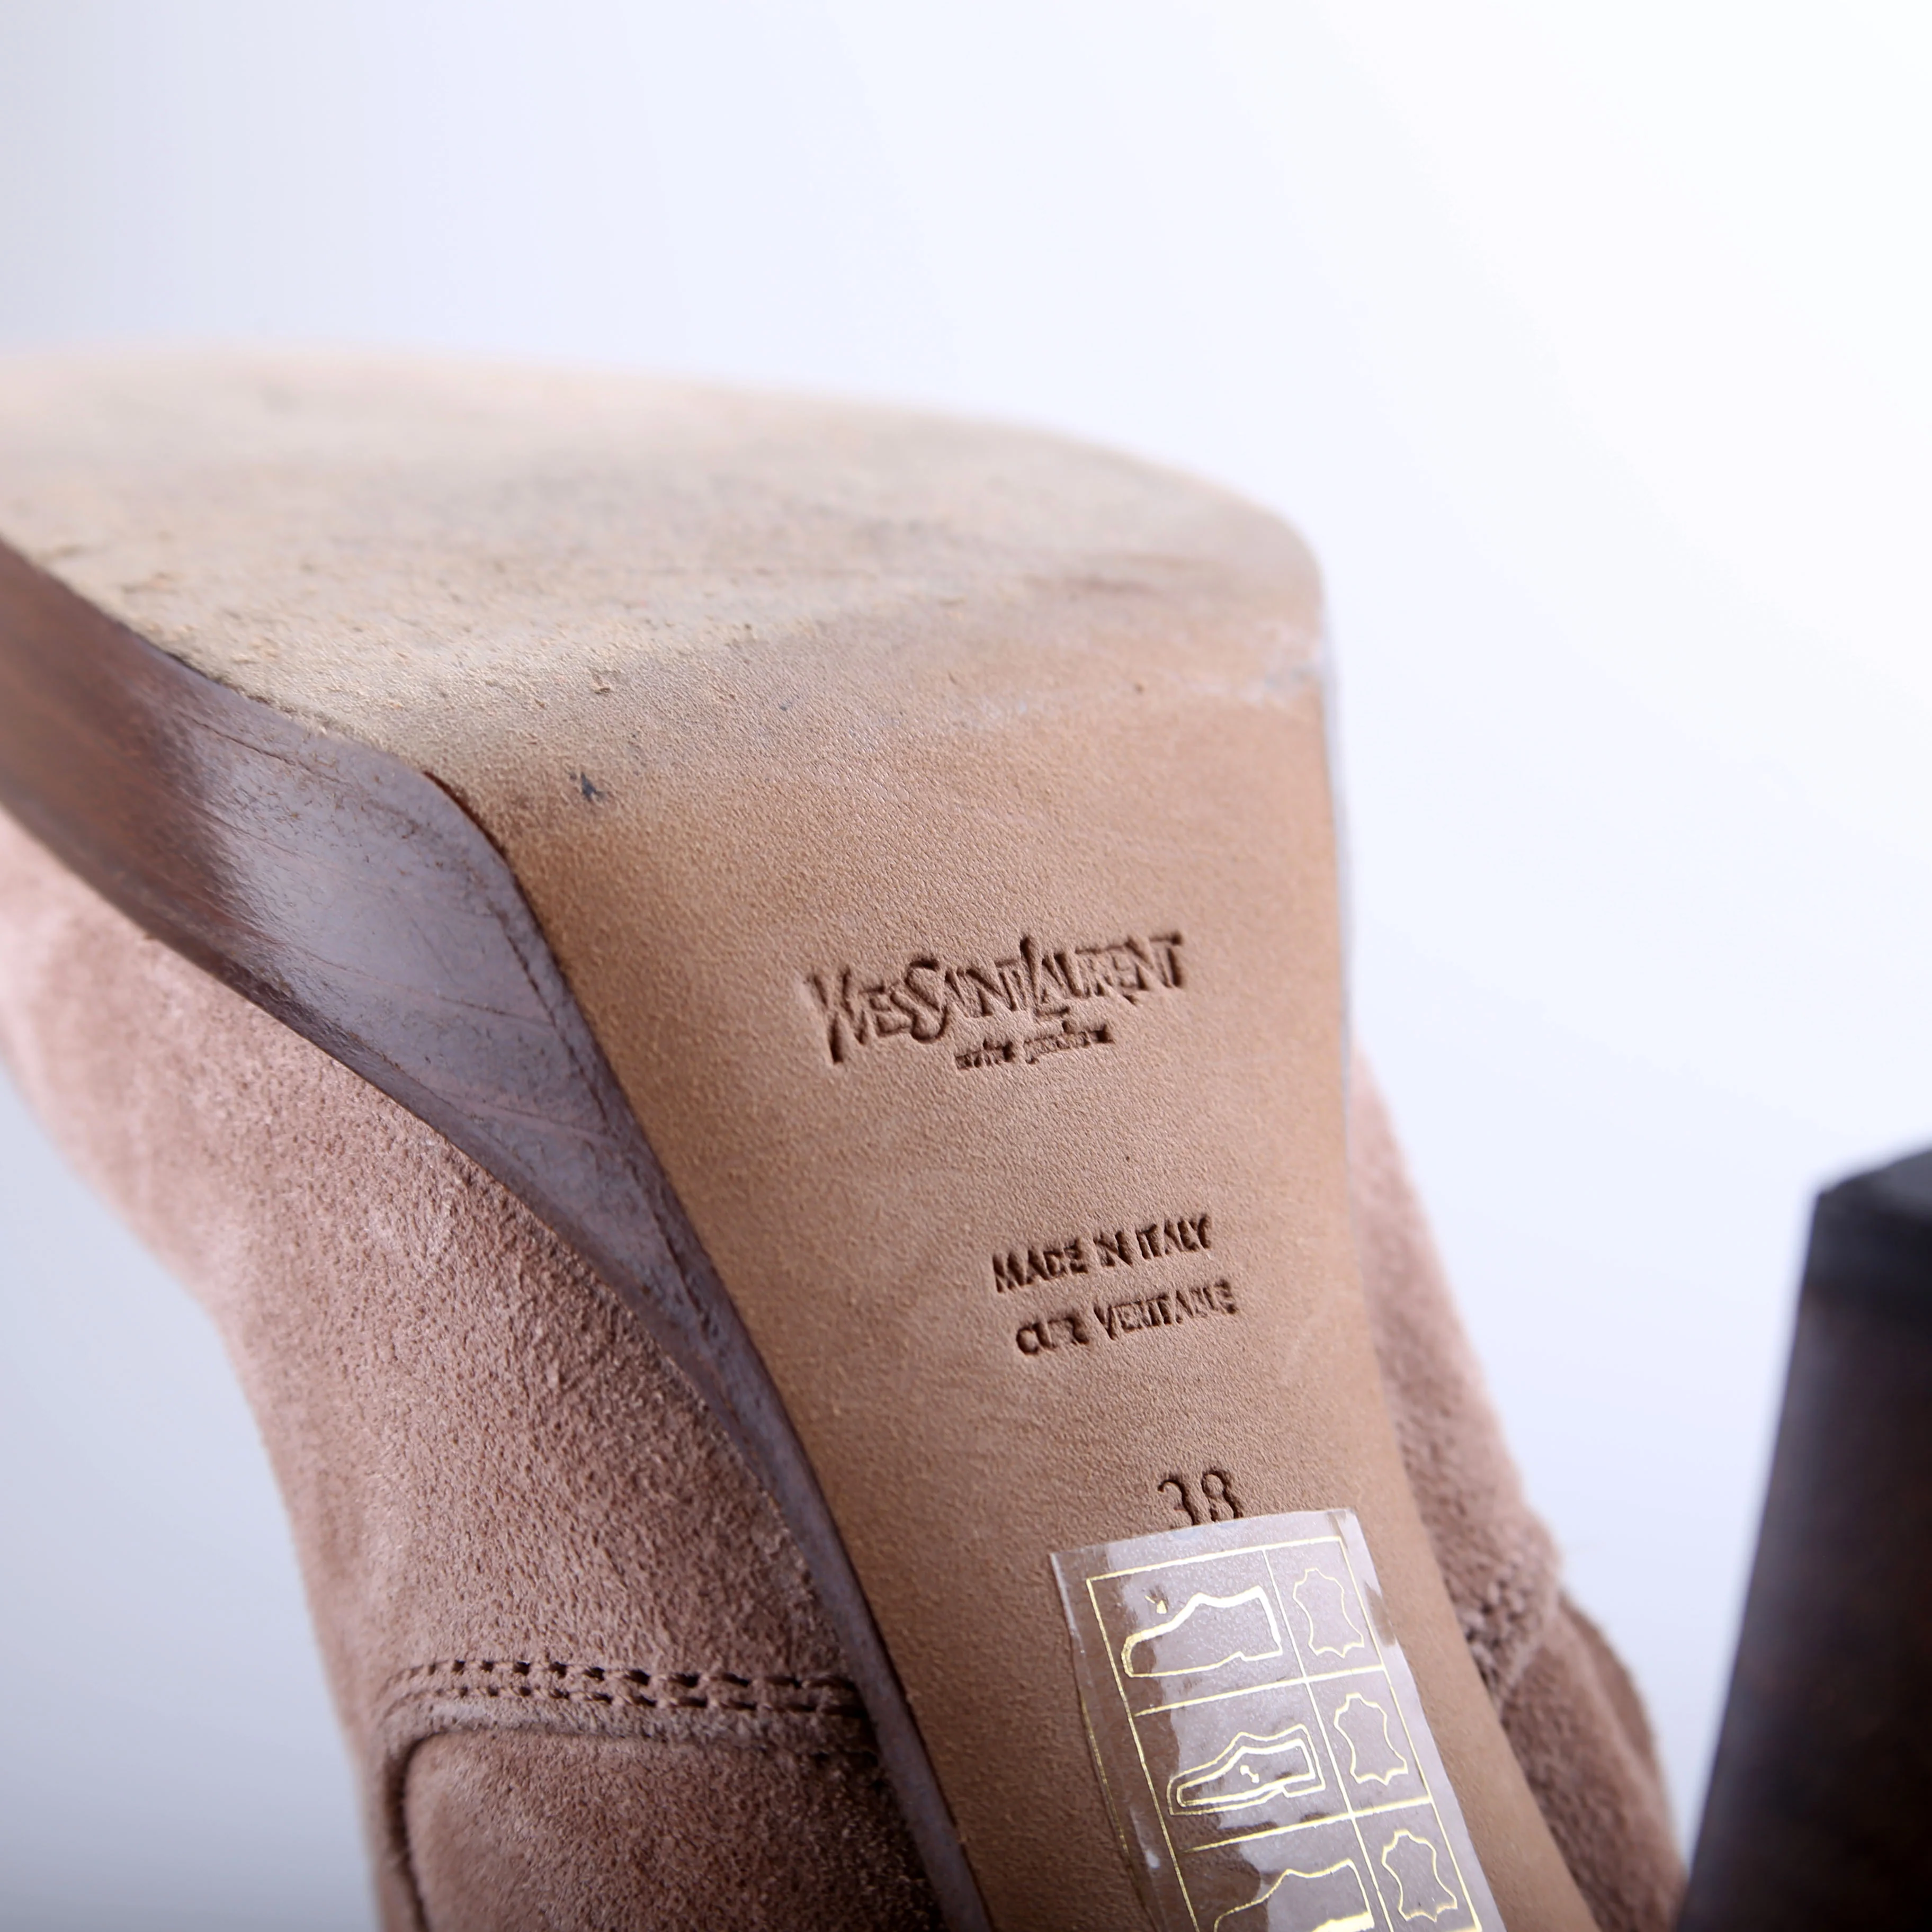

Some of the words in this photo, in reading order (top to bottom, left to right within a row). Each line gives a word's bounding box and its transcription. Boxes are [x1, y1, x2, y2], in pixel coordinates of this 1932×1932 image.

[992, 1237, 1089, 1293] MADE
[1093, 1230, 1134, 1267] IN
[1135, 1213, 1212, 1260] ITALY
[1157, 1467, 1245, 1526] 38
